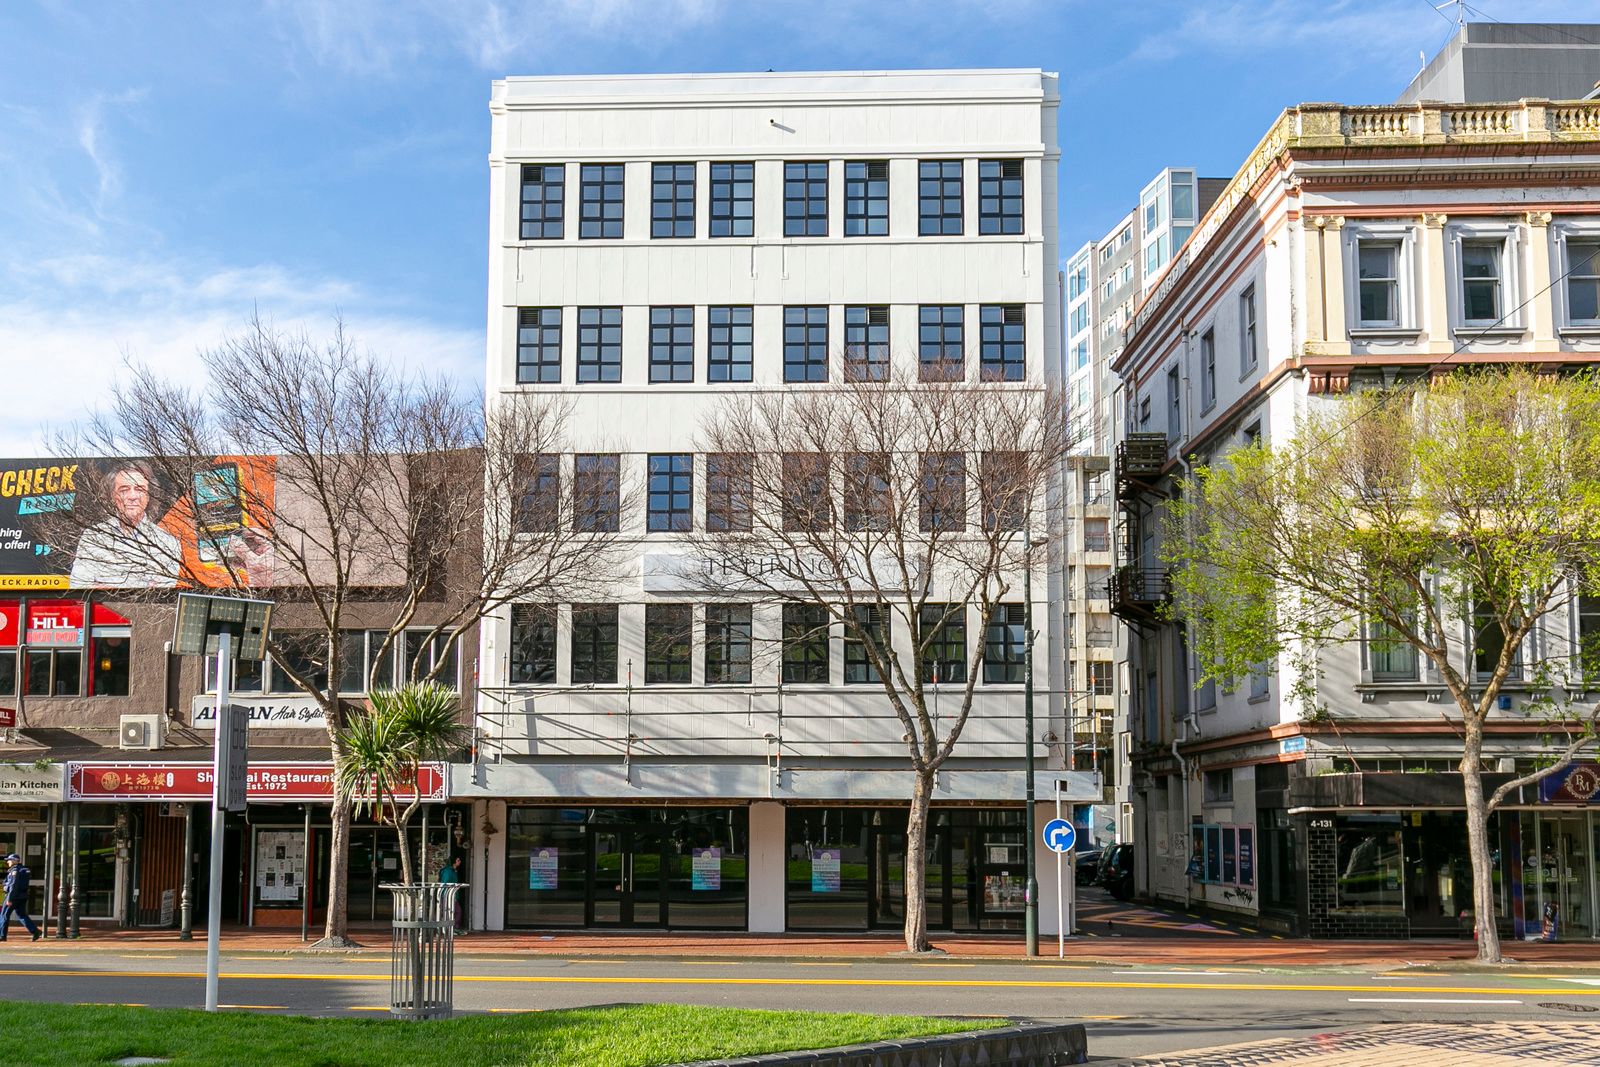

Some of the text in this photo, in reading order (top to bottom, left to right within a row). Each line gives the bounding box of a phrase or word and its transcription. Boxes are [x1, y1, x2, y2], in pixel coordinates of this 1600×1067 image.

[0, 464, 79, 498] CHECK
[0, 528, 22, 539] hing
[4, 541, 31, 549] offer!
[32, 617, 76, 629] HILL
[271, 705, 297, 720] Hair
[262, 772, 336, 783] Restaurant
[0, 780, 59, 789] ian Kitchen
[1310, 819, 1333, 828] 4-131
